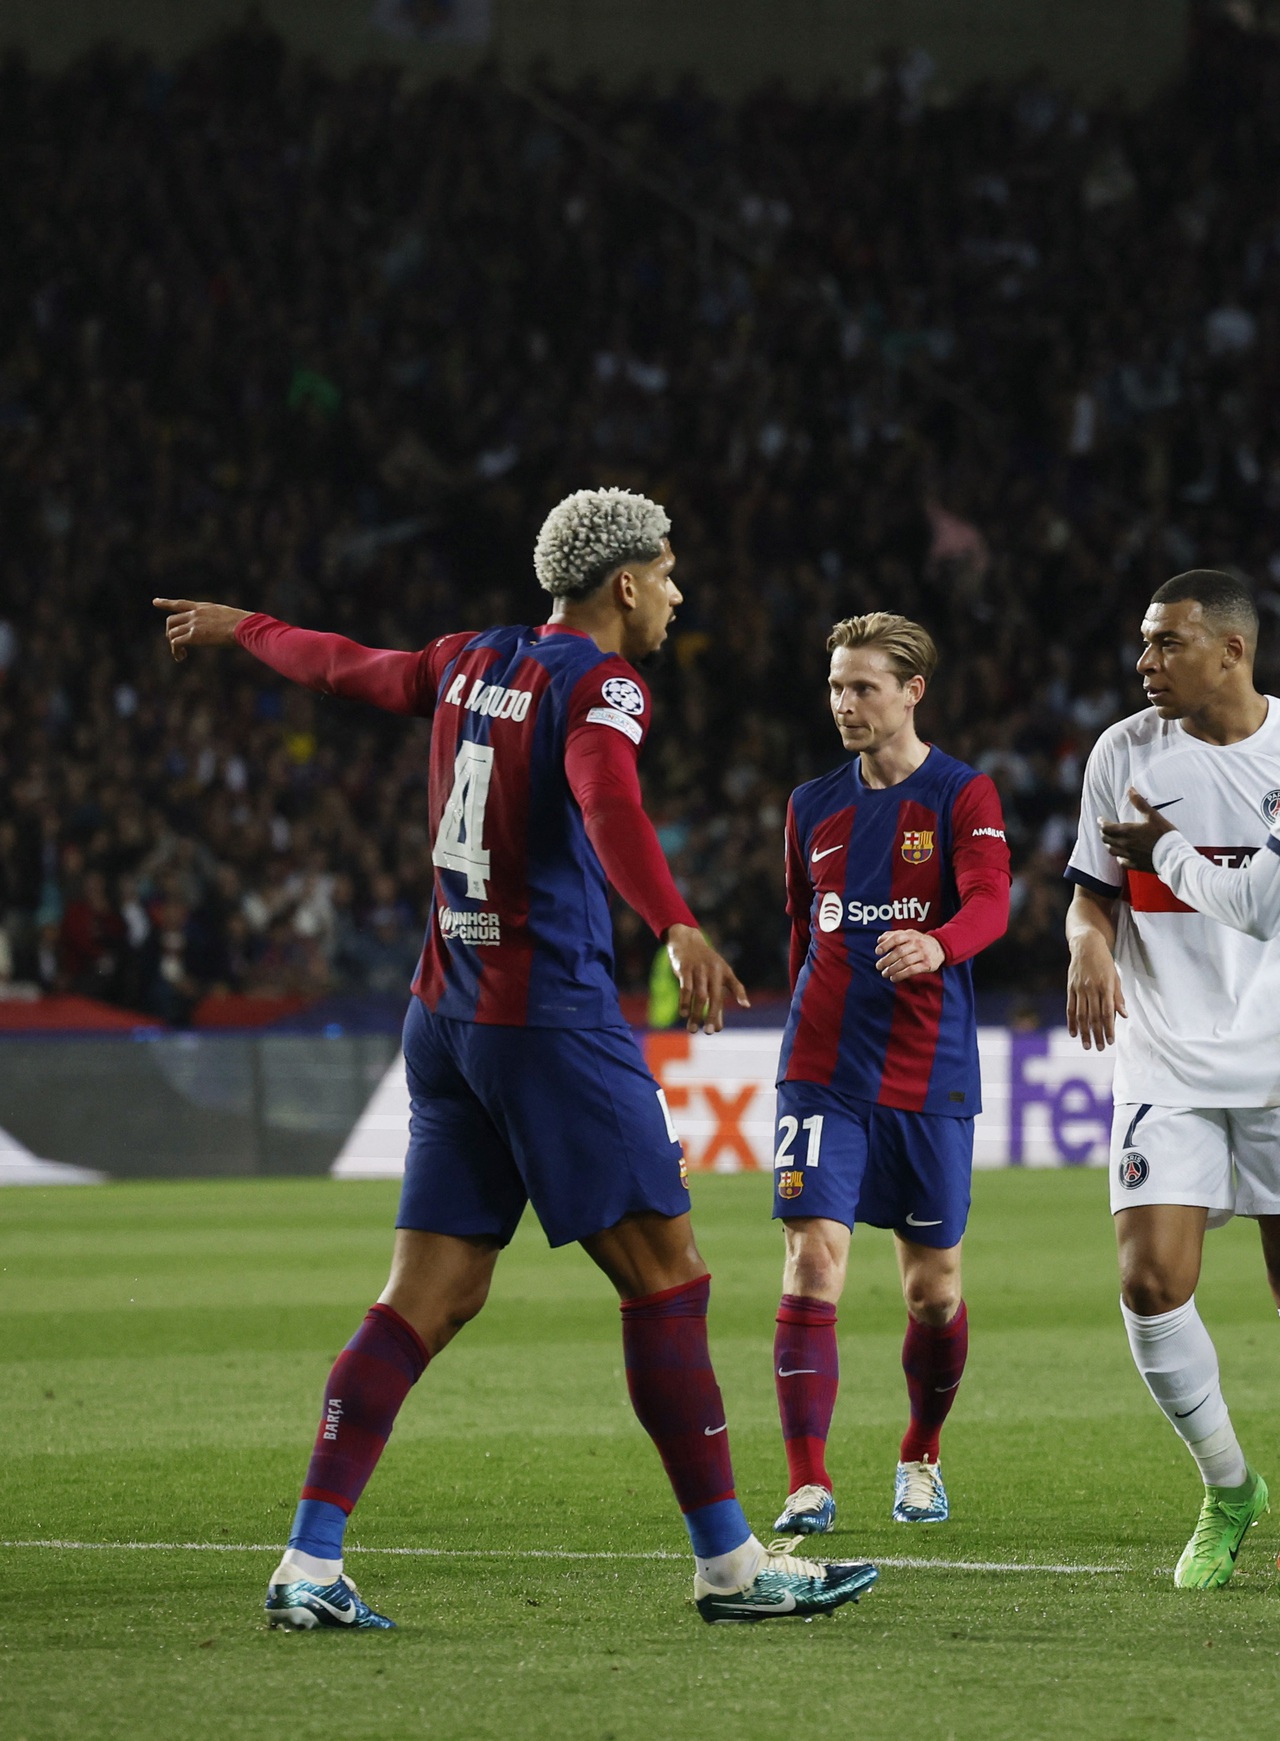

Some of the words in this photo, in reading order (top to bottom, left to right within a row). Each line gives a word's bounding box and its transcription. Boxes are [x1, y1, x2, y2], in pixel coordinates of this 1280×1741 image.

[445, 673, 467, 706] R.
[432, 740, 494, 900] 4
[848, 897, 931, 925] Spotify
[459, 926, 500, 939] CNUR
[775, 1115, 824, 1169] 21
[323, 1399, 344, 1440] BARÇA
